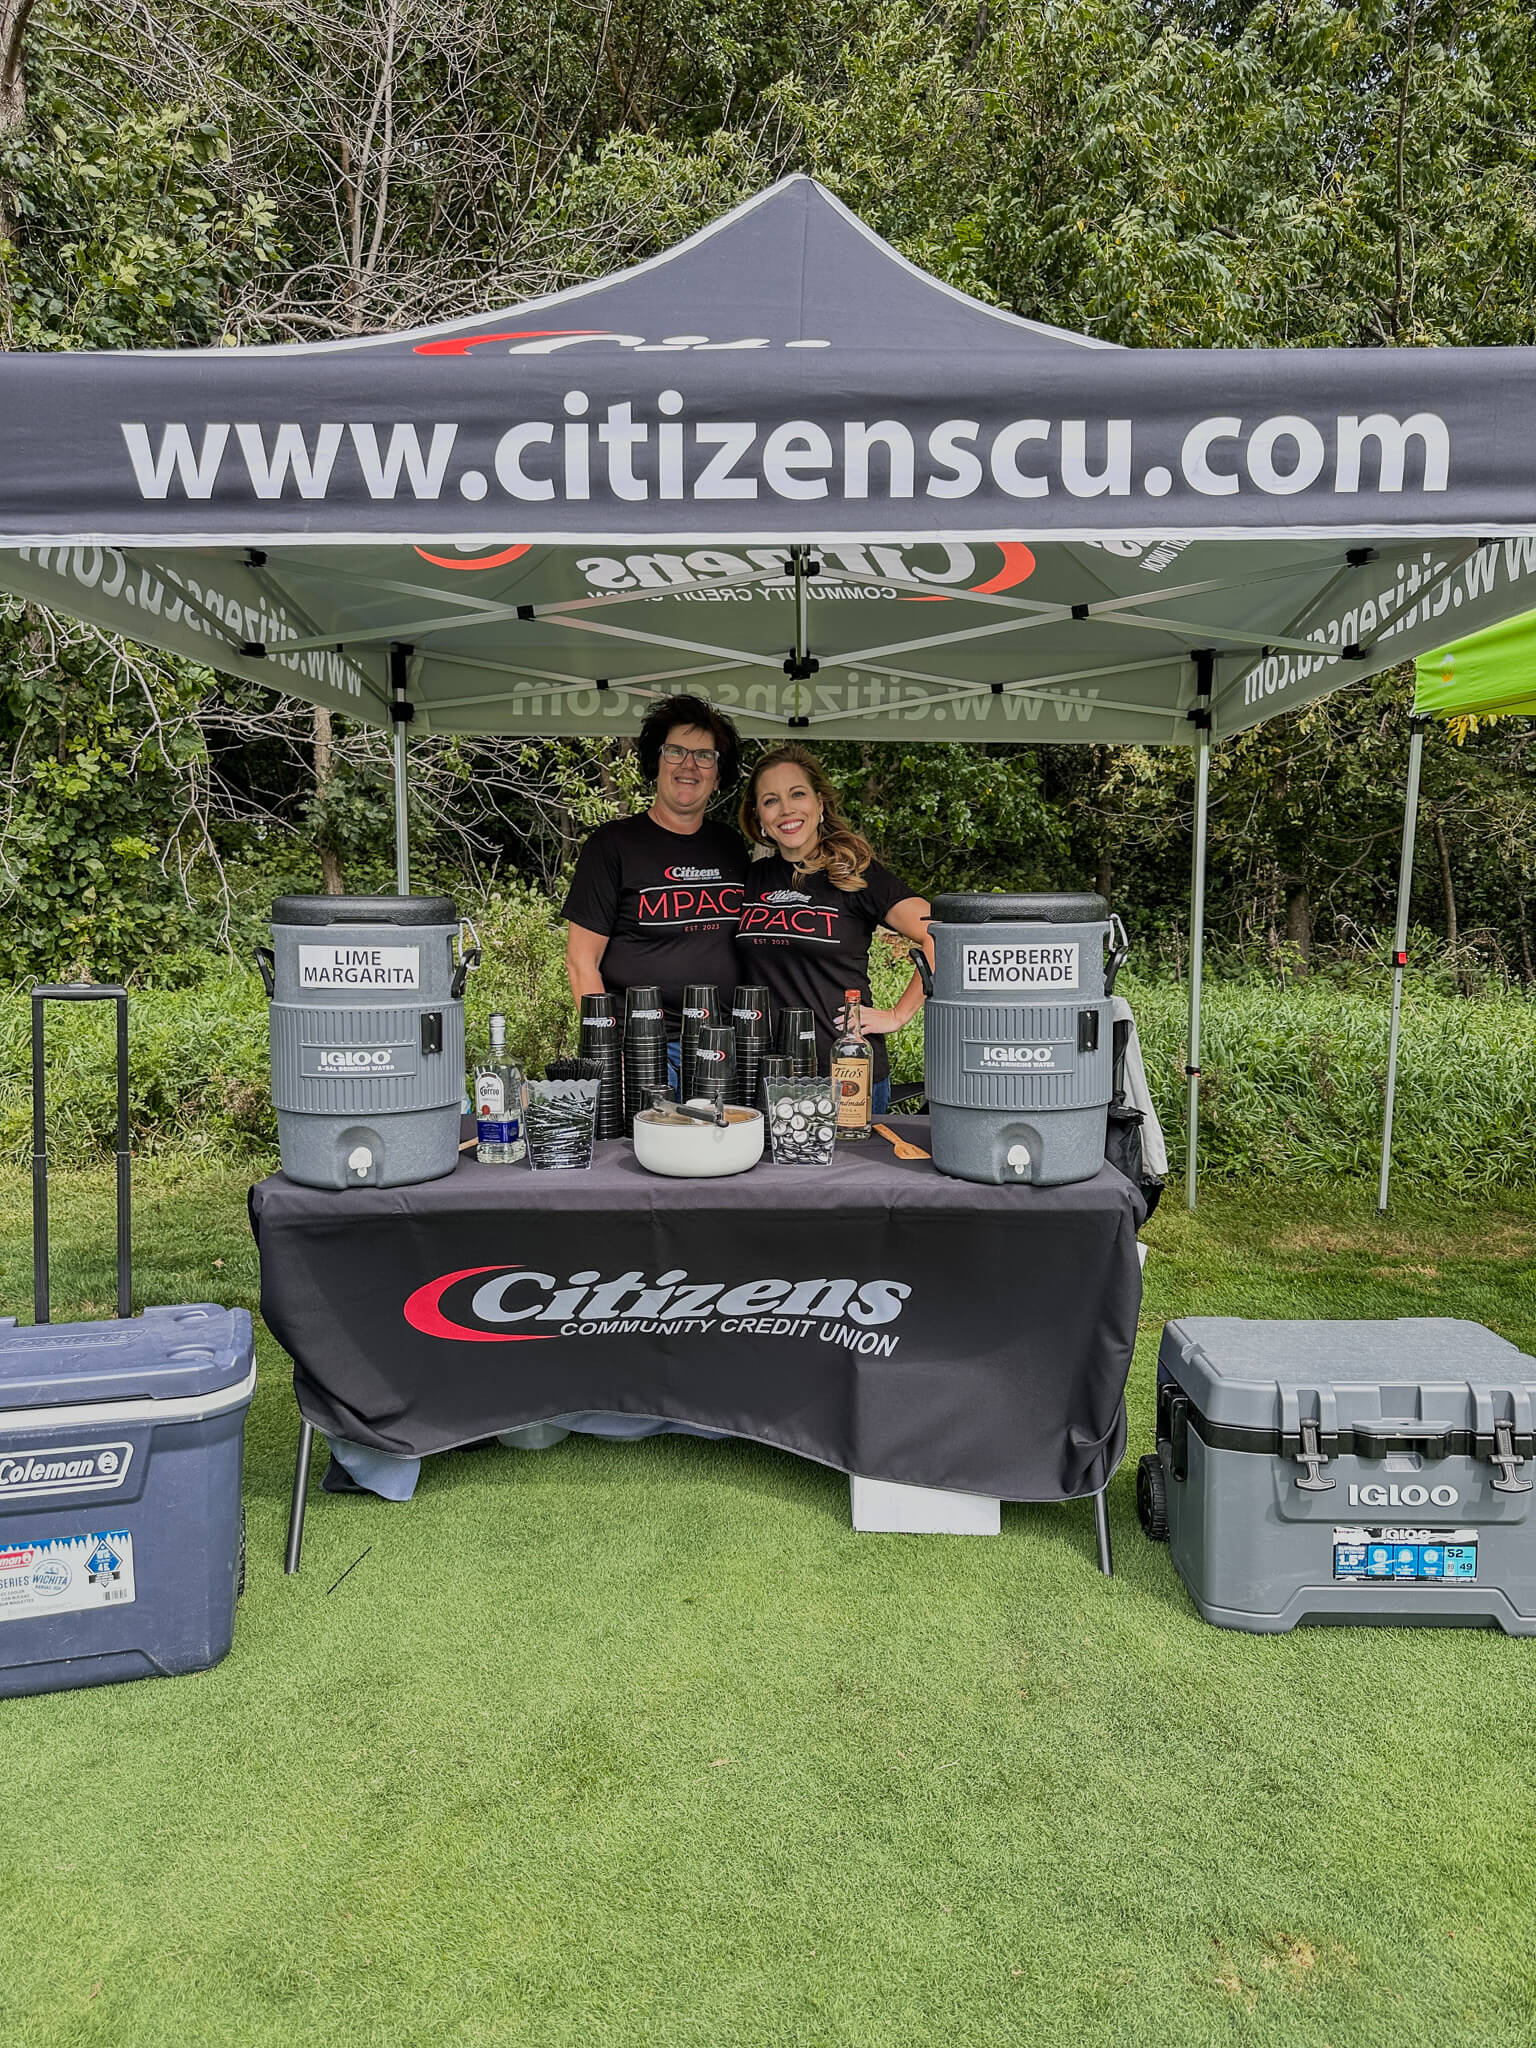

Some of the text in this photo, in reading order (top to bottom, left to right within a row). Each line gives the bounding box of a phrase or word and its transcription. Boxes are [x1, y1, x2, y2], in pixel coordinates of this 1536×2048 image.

[121, 389, 1451, 501] www.citizenscu.com
[672, 866, 720, 878] Citizens
[702, 923, 720, 931] 2023
[334, 950, 382, 966] LIME
[967, 949, 1074, 966] RASPBERRY
[304, 967, 415, 984] MARGARITA
[968, 965, 1073, 982] LEMONADE
[320, 1051, 391, 1066] IGLOO
[983, 1047, 1052, 1062] IGLOO
[834, 1067, 863, 1079] Tito's
[472, 1269, 913, 1325] Citizens
[560, 1317, 899, 1357] COMMUNITY CREDIT UNION
[0, 1457, 94, 1485] Coleman
[1348, 1483, 1459, 1506] IGLOO
[1447, 1549, 1464, 1558] 52
[1460, 1563, 1473, 1571] 49
[32, 1574, 68, 1586] WICHITA
